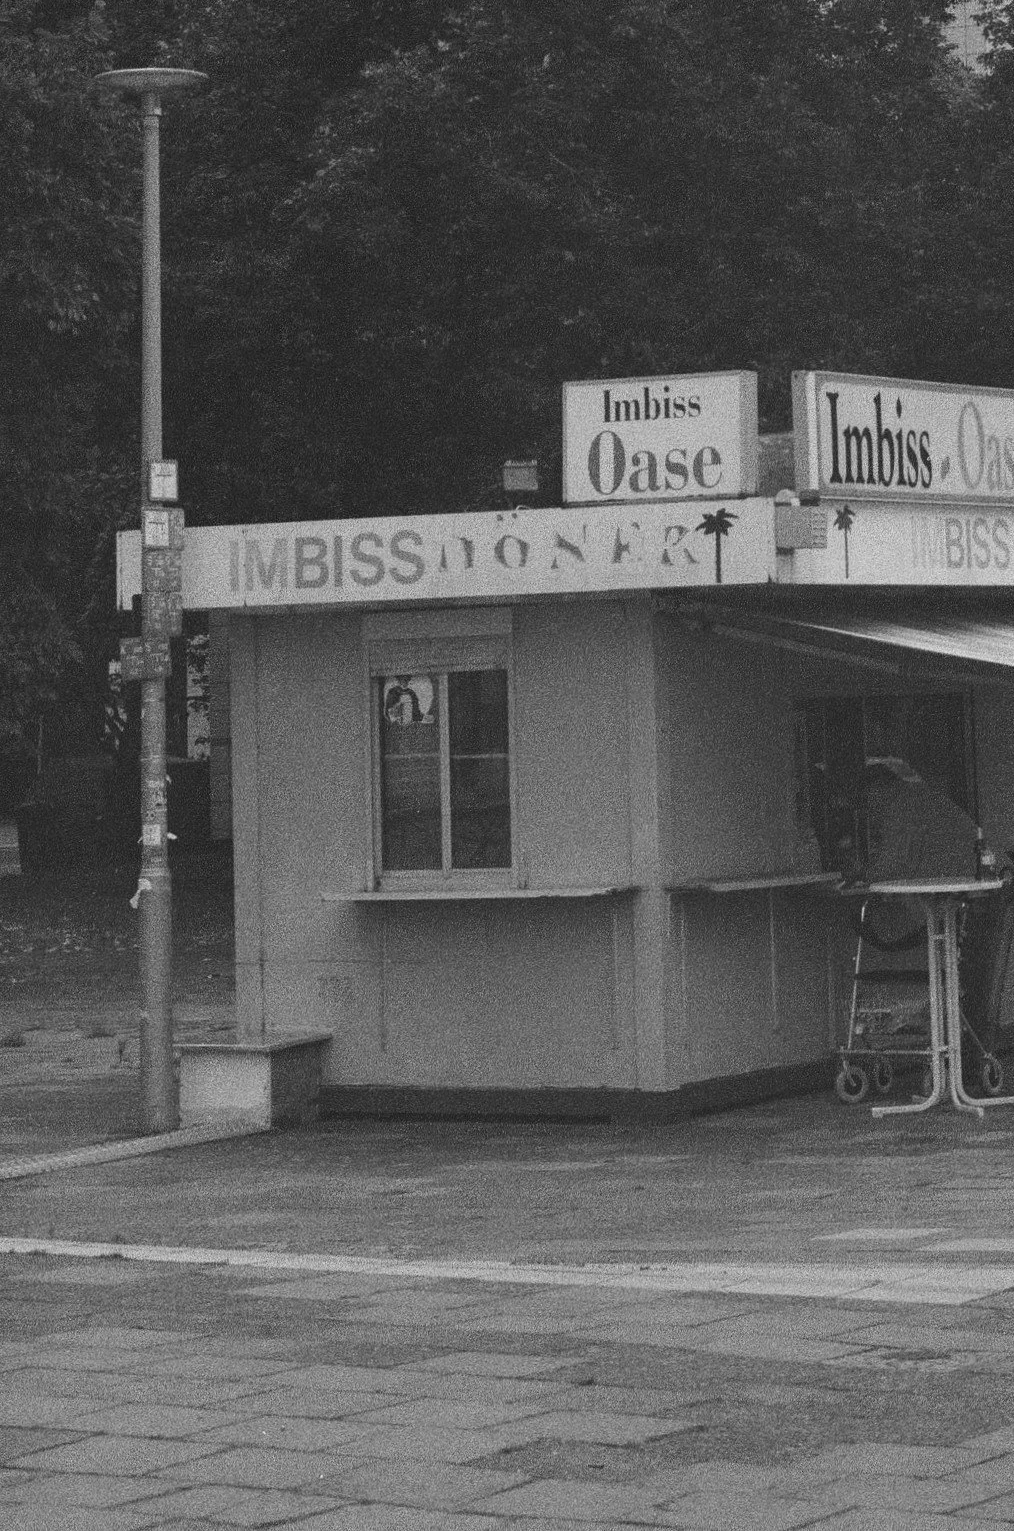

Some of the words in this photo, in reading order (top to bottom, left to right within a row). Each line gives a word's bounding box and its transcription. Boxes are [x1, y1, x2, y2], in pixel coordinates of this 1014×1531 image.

[603, 385, 701, 423] Imbiss
[587, 430, 723, 495] Oase
[826, 392, 933, 488] Imbiss
[229, 530, 426, 593] IMBISS
